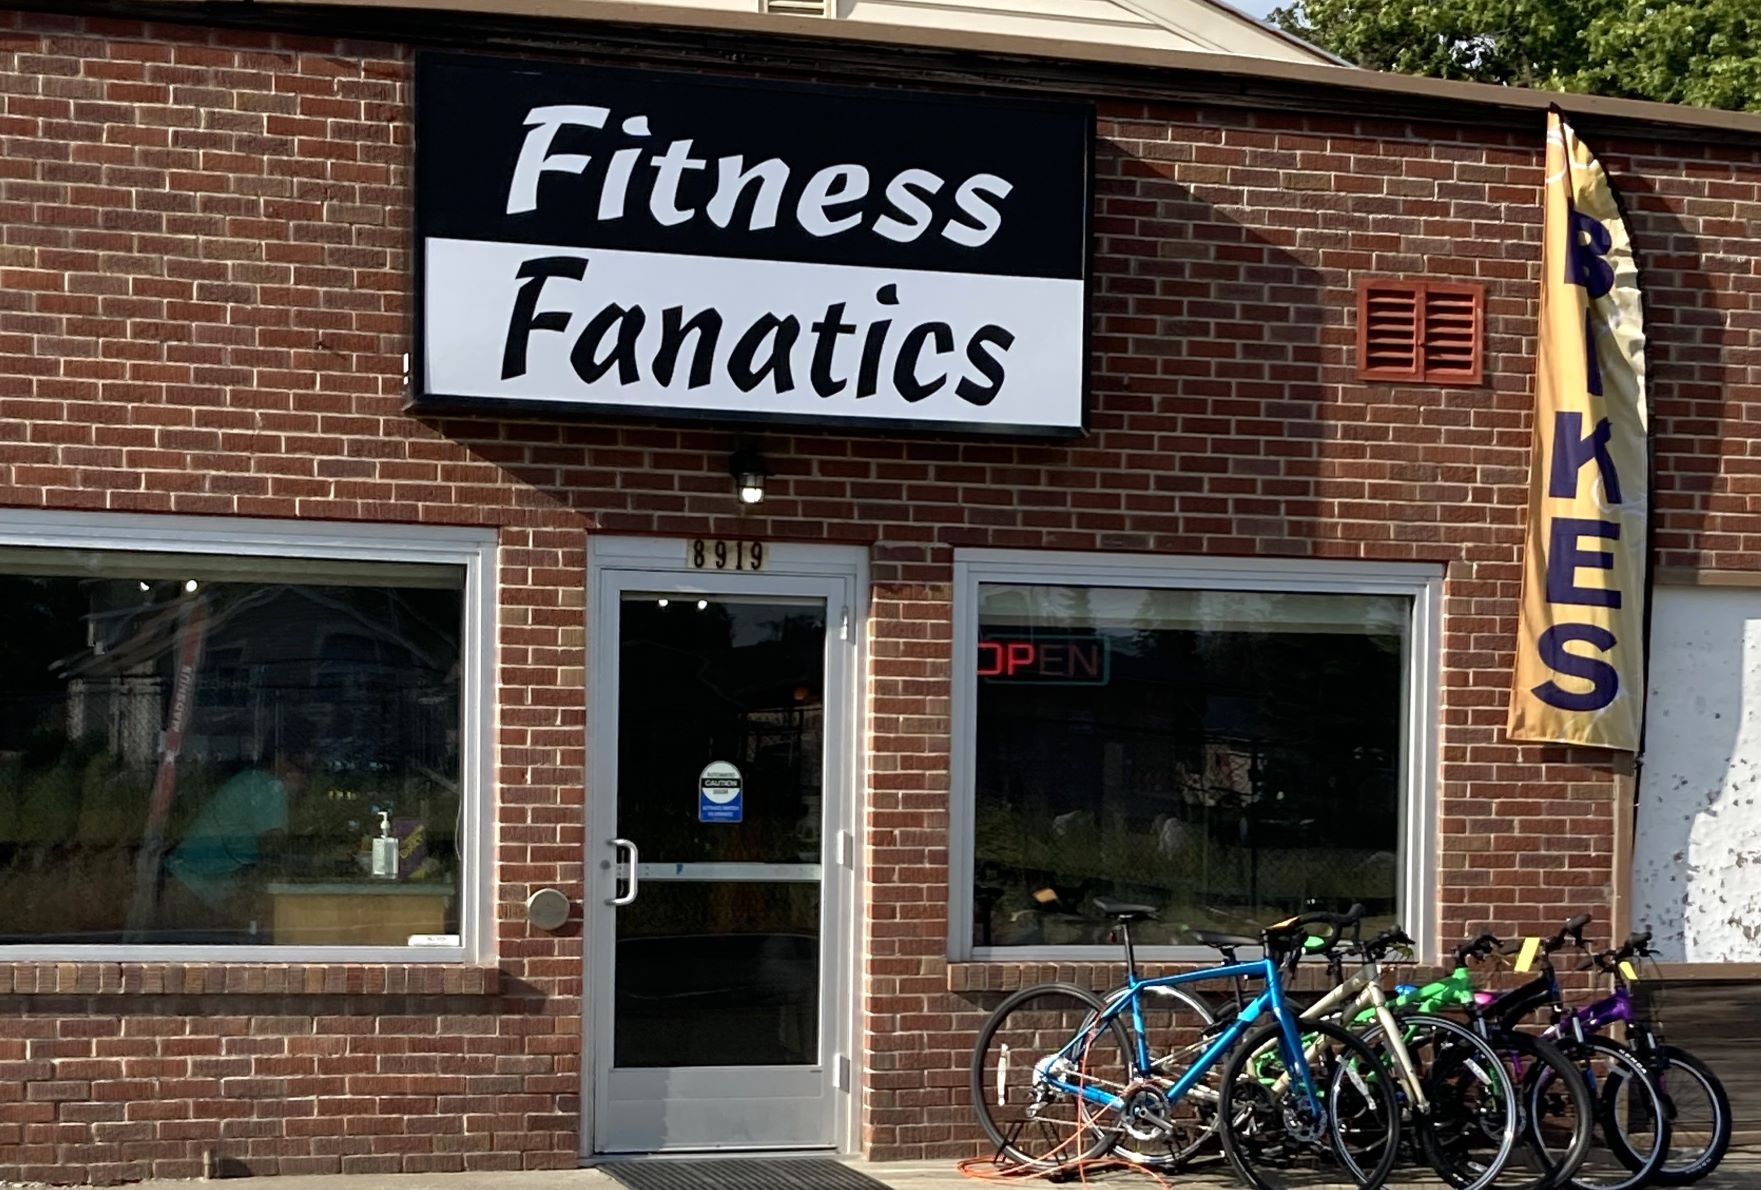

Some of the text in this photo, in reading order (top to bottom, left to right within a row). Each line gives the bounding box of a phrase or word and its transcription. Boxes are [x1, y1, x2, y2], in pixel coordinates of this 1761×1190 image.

[506, 104, 1014, 248] Fitness
[500, 256, 1016, 407] Fanatics
[1530, 208, 1622, 713] BIKES
[693, 539, 763, 571] 8919
[976, 642, 1099, 678] OPEN
[704, 779, 738, 787] CAUTION
